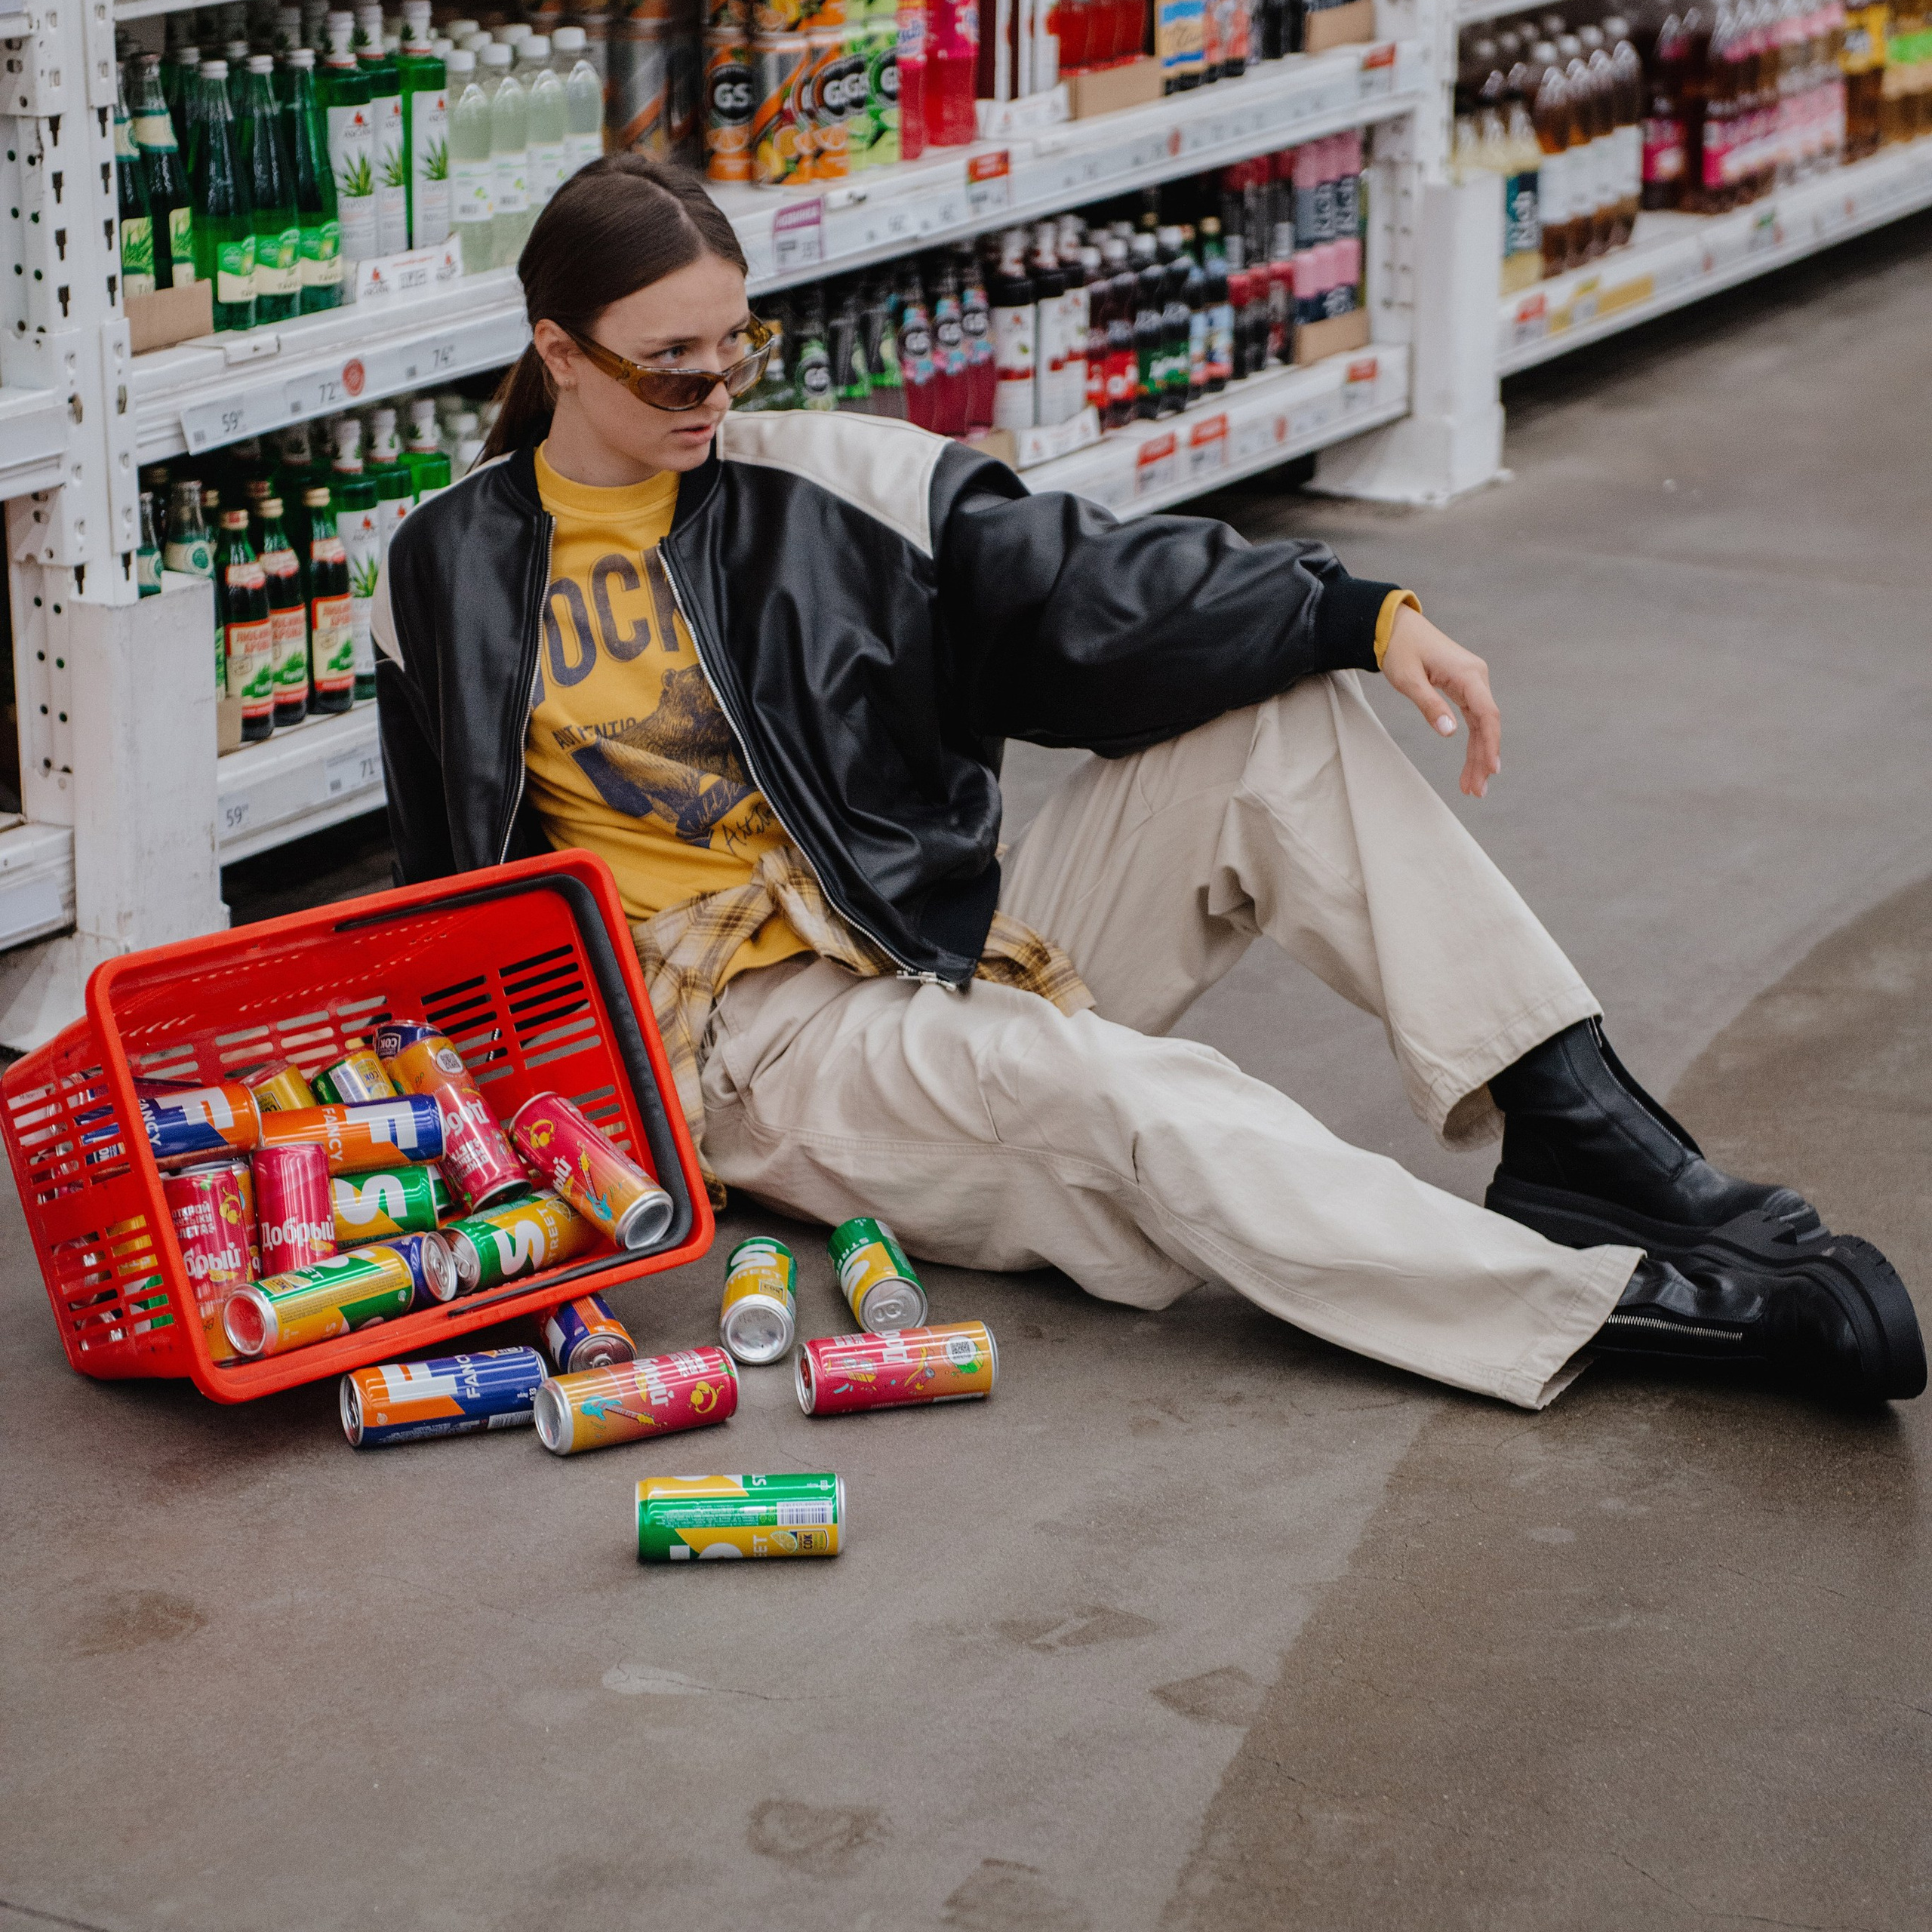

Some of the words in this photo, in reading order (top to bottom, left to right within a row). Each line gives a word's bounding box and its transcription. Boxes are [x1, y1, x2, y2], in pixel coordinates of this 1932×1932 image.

[714, 82, 750, 108] GS
[531, 546, 686, 711] OCK
[380, 1038, 397, 1049] СОК
[138, 1097, 162, 1146] ANCY
[321, 1106, 343, 1161] FANCY
[260, 1214, 335, 1251] Добрый
[536, 1207, 559, 1263] TREET
[183, 1241, 242, 1279] брый
[729, 1268, 783, 1284] TREET
[874, 1331, 913, 1363] Доб
[454, 1354, 481, 1399] FANC
[632, 1358, 674, 1406] брый
[803, 1534, 813, 1550] СОК
